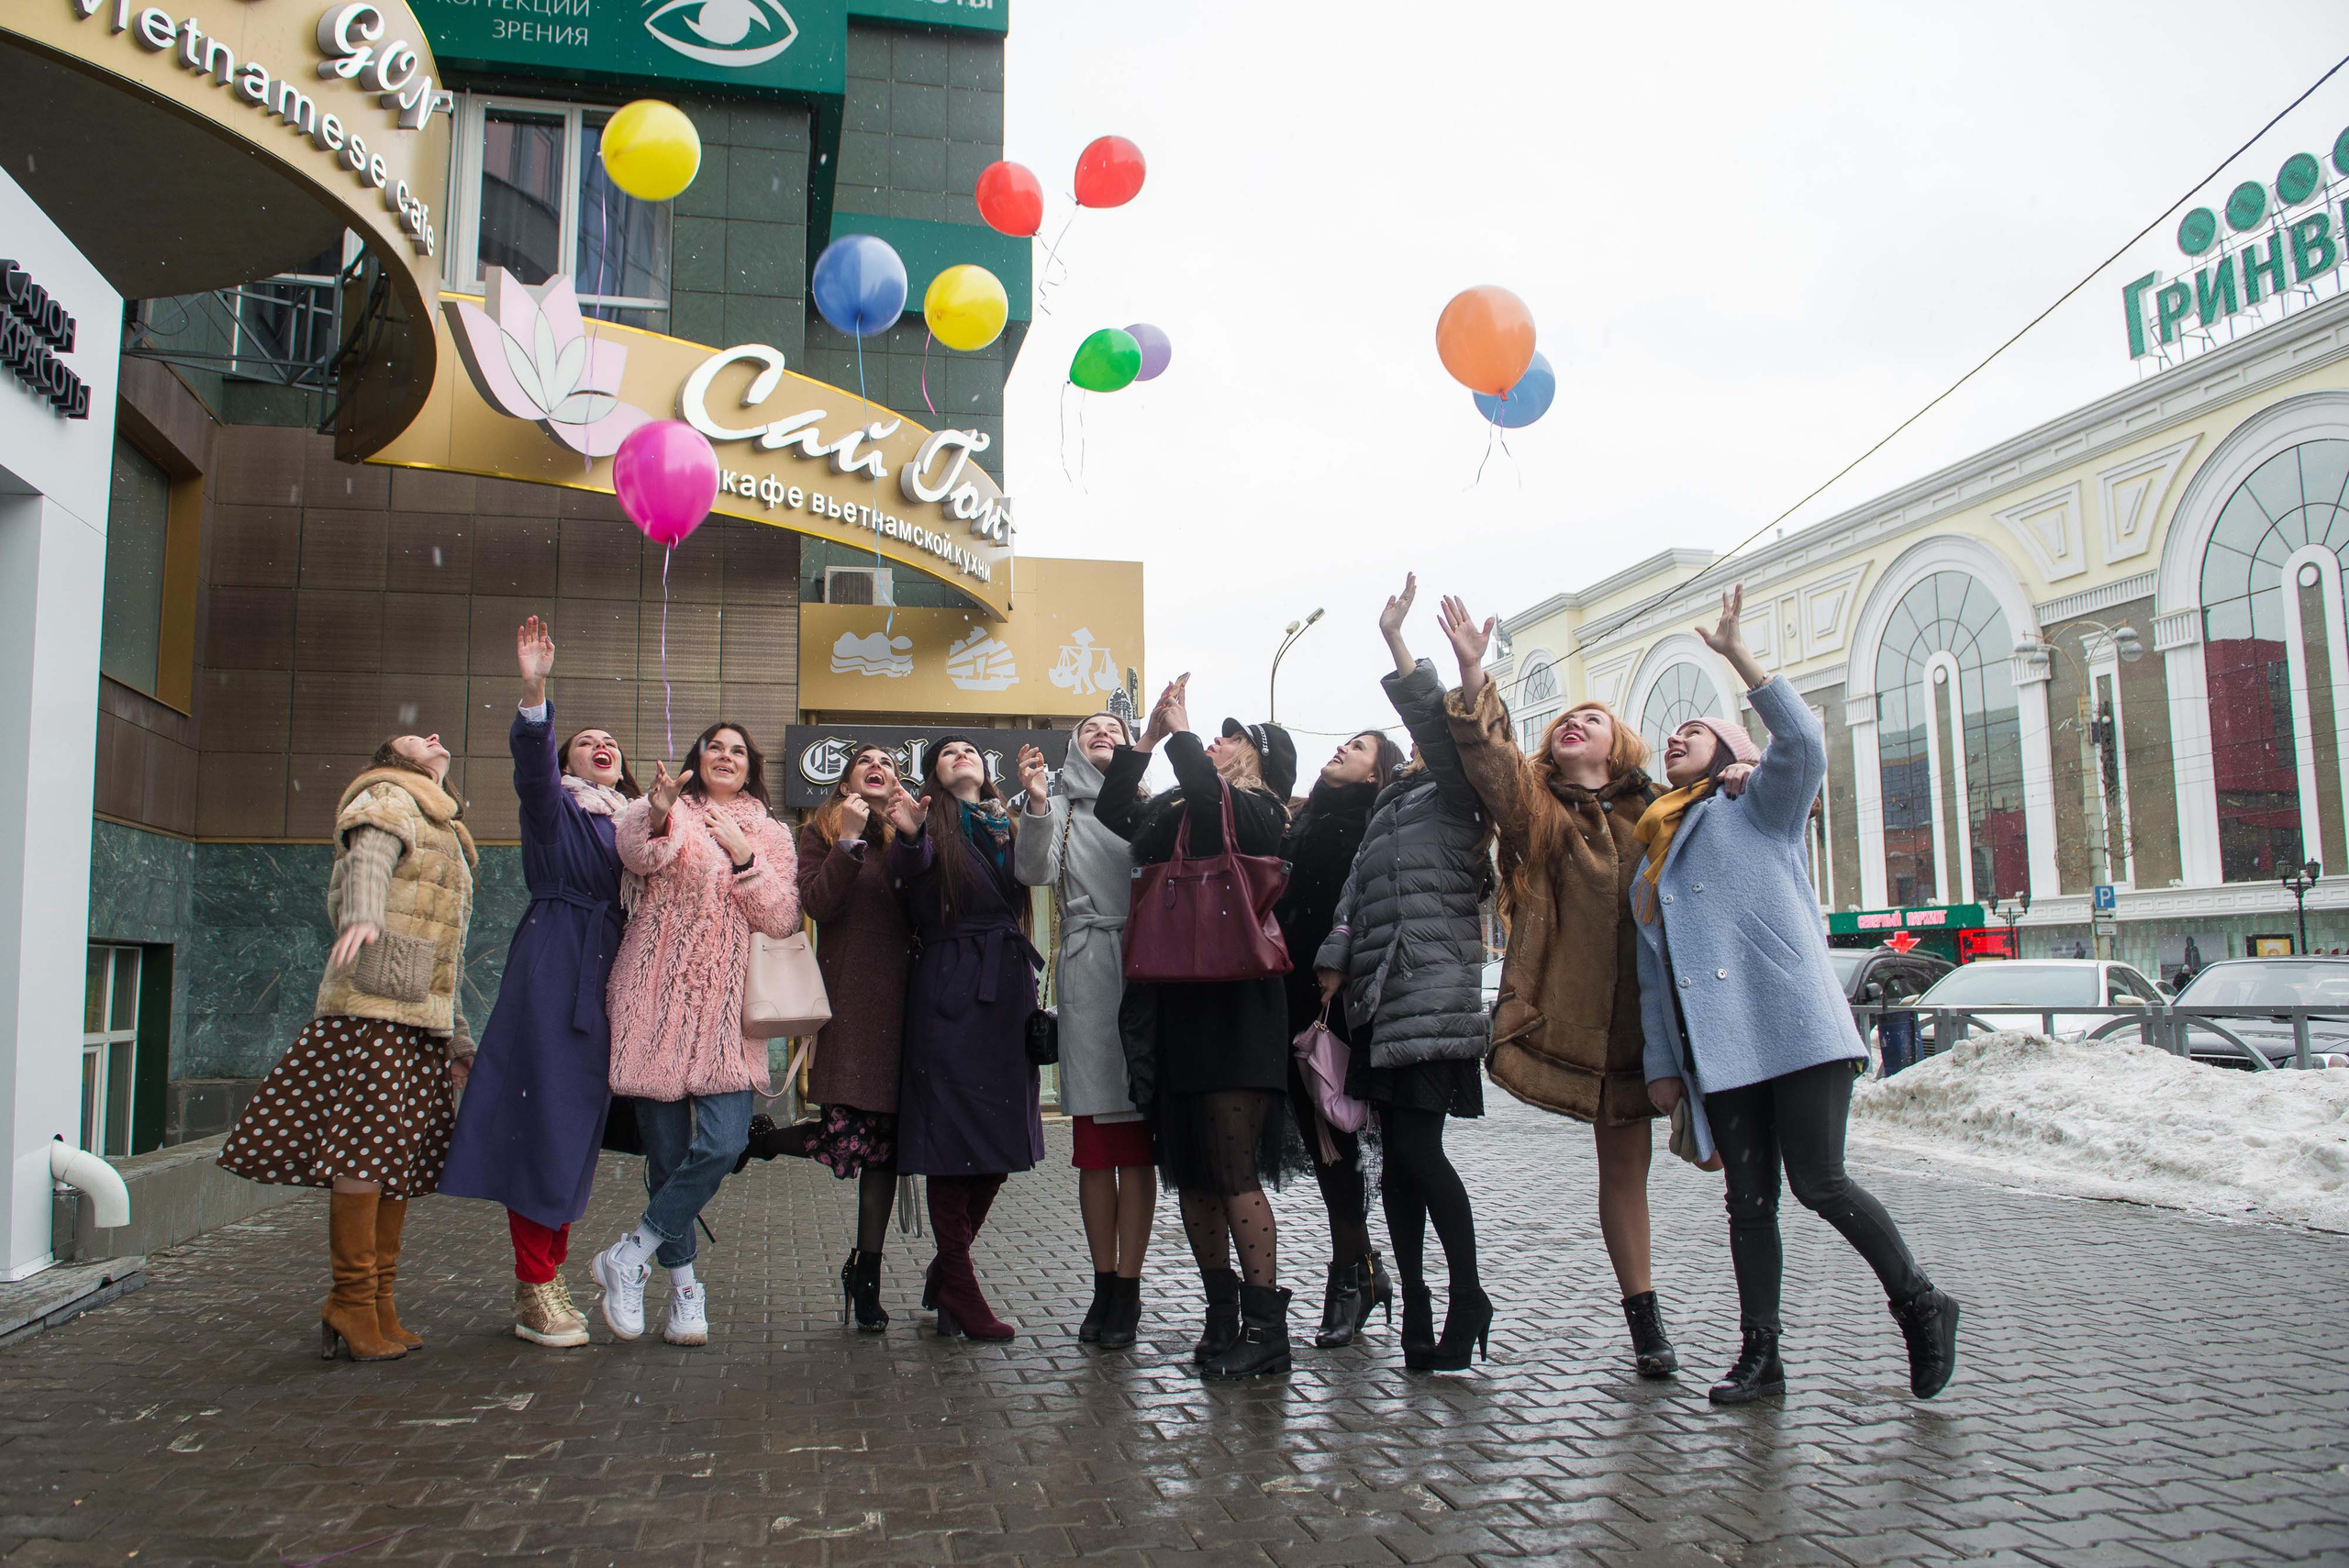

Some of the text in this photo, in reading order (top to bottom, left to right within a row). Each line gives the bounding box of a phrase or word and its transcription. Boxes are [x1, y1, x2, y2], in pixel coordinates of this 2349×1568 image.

[436, 0, 589, 17] ЕКЦИИ
[492, 18, 588, 46] ЗРЕНИЯ
[386, 179, 435, 257] cafe
[0, 259, 77, 354] САЛОН
[2122, 198, 2349, 360] ГРИНВ
[0, 310, 92, 419] КРАСОТЫ
[677, 343, 901, 477] Сай
[720, 468, 992, 584] кафе вьетнамской кухни
[2099, 887, 2111, 907] P
